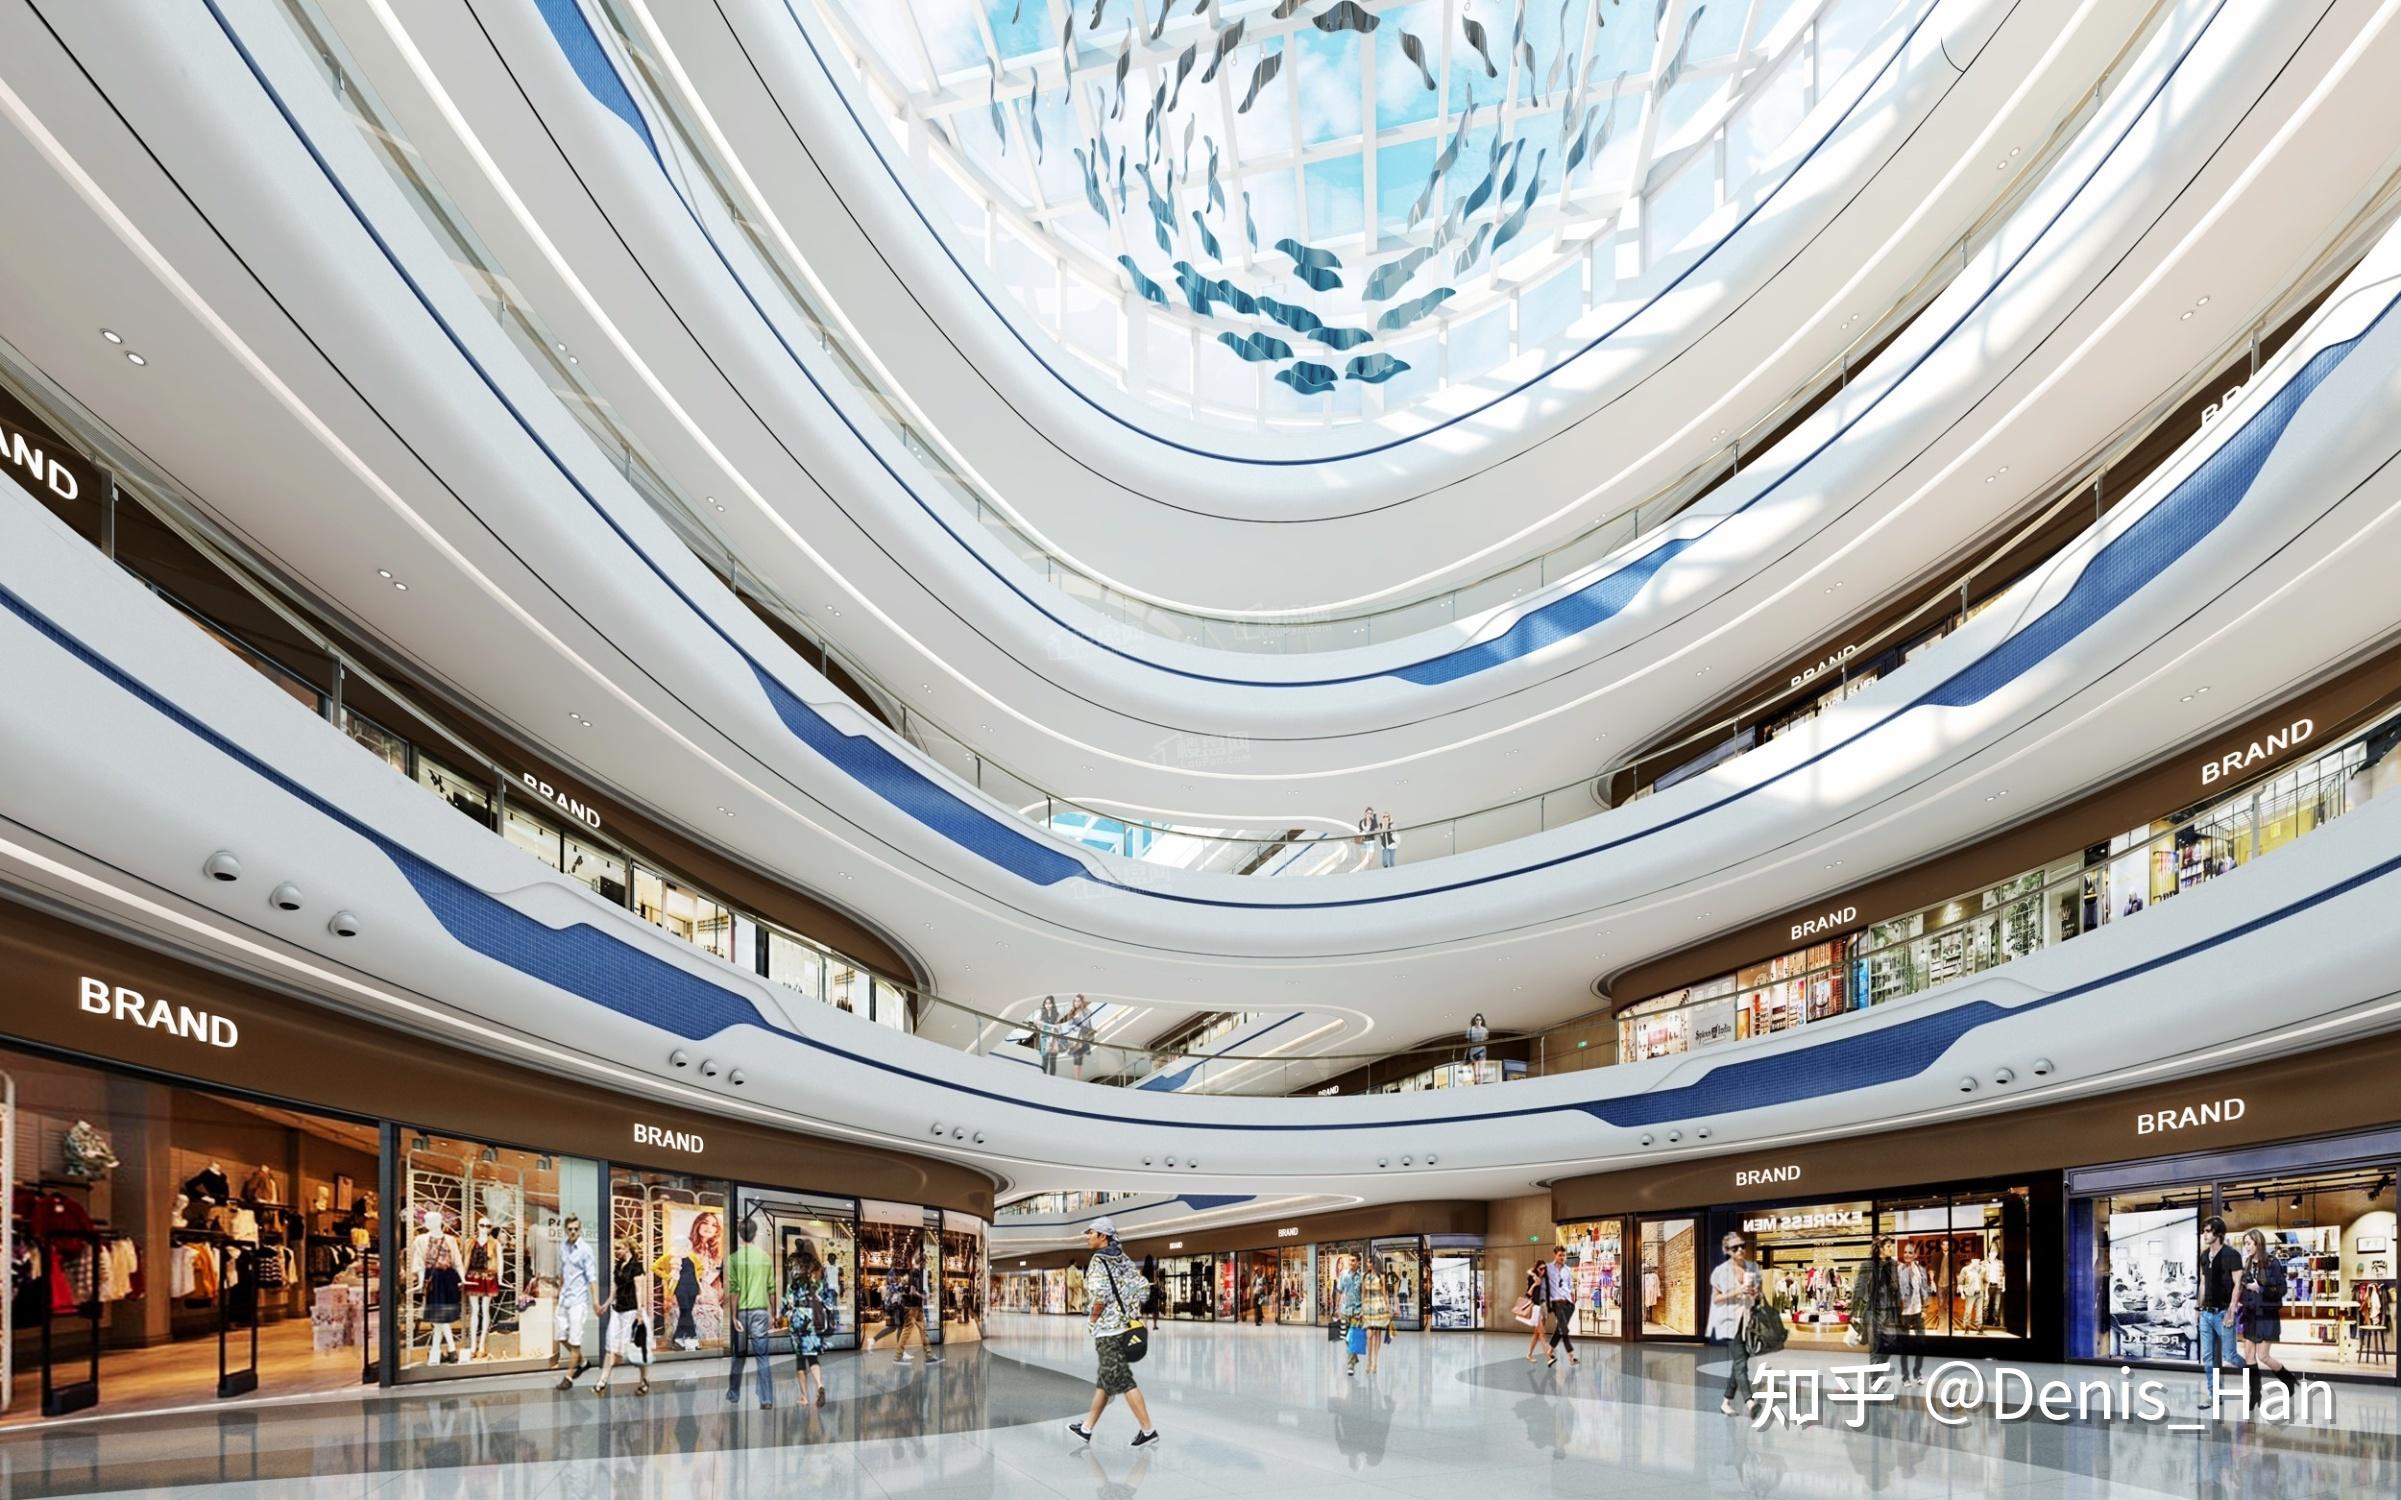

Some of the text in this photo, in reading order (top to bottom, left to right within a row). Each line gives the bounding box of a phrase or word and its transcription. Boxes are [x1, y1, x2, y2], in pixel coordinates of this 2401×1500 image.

[2202, 718, 2314, 785] BRAND
[1791, 906, 1857, 940] BRAND
[78, 976, 239, 1048] BRAND
[2137, 1098, 2246, 1135] BRAND
[634, 1122, 704, 1153] BRAND
[1736, 1165, 1801, 1186] BRAND
[1278, 1227, 1299, 1238] BRAND
